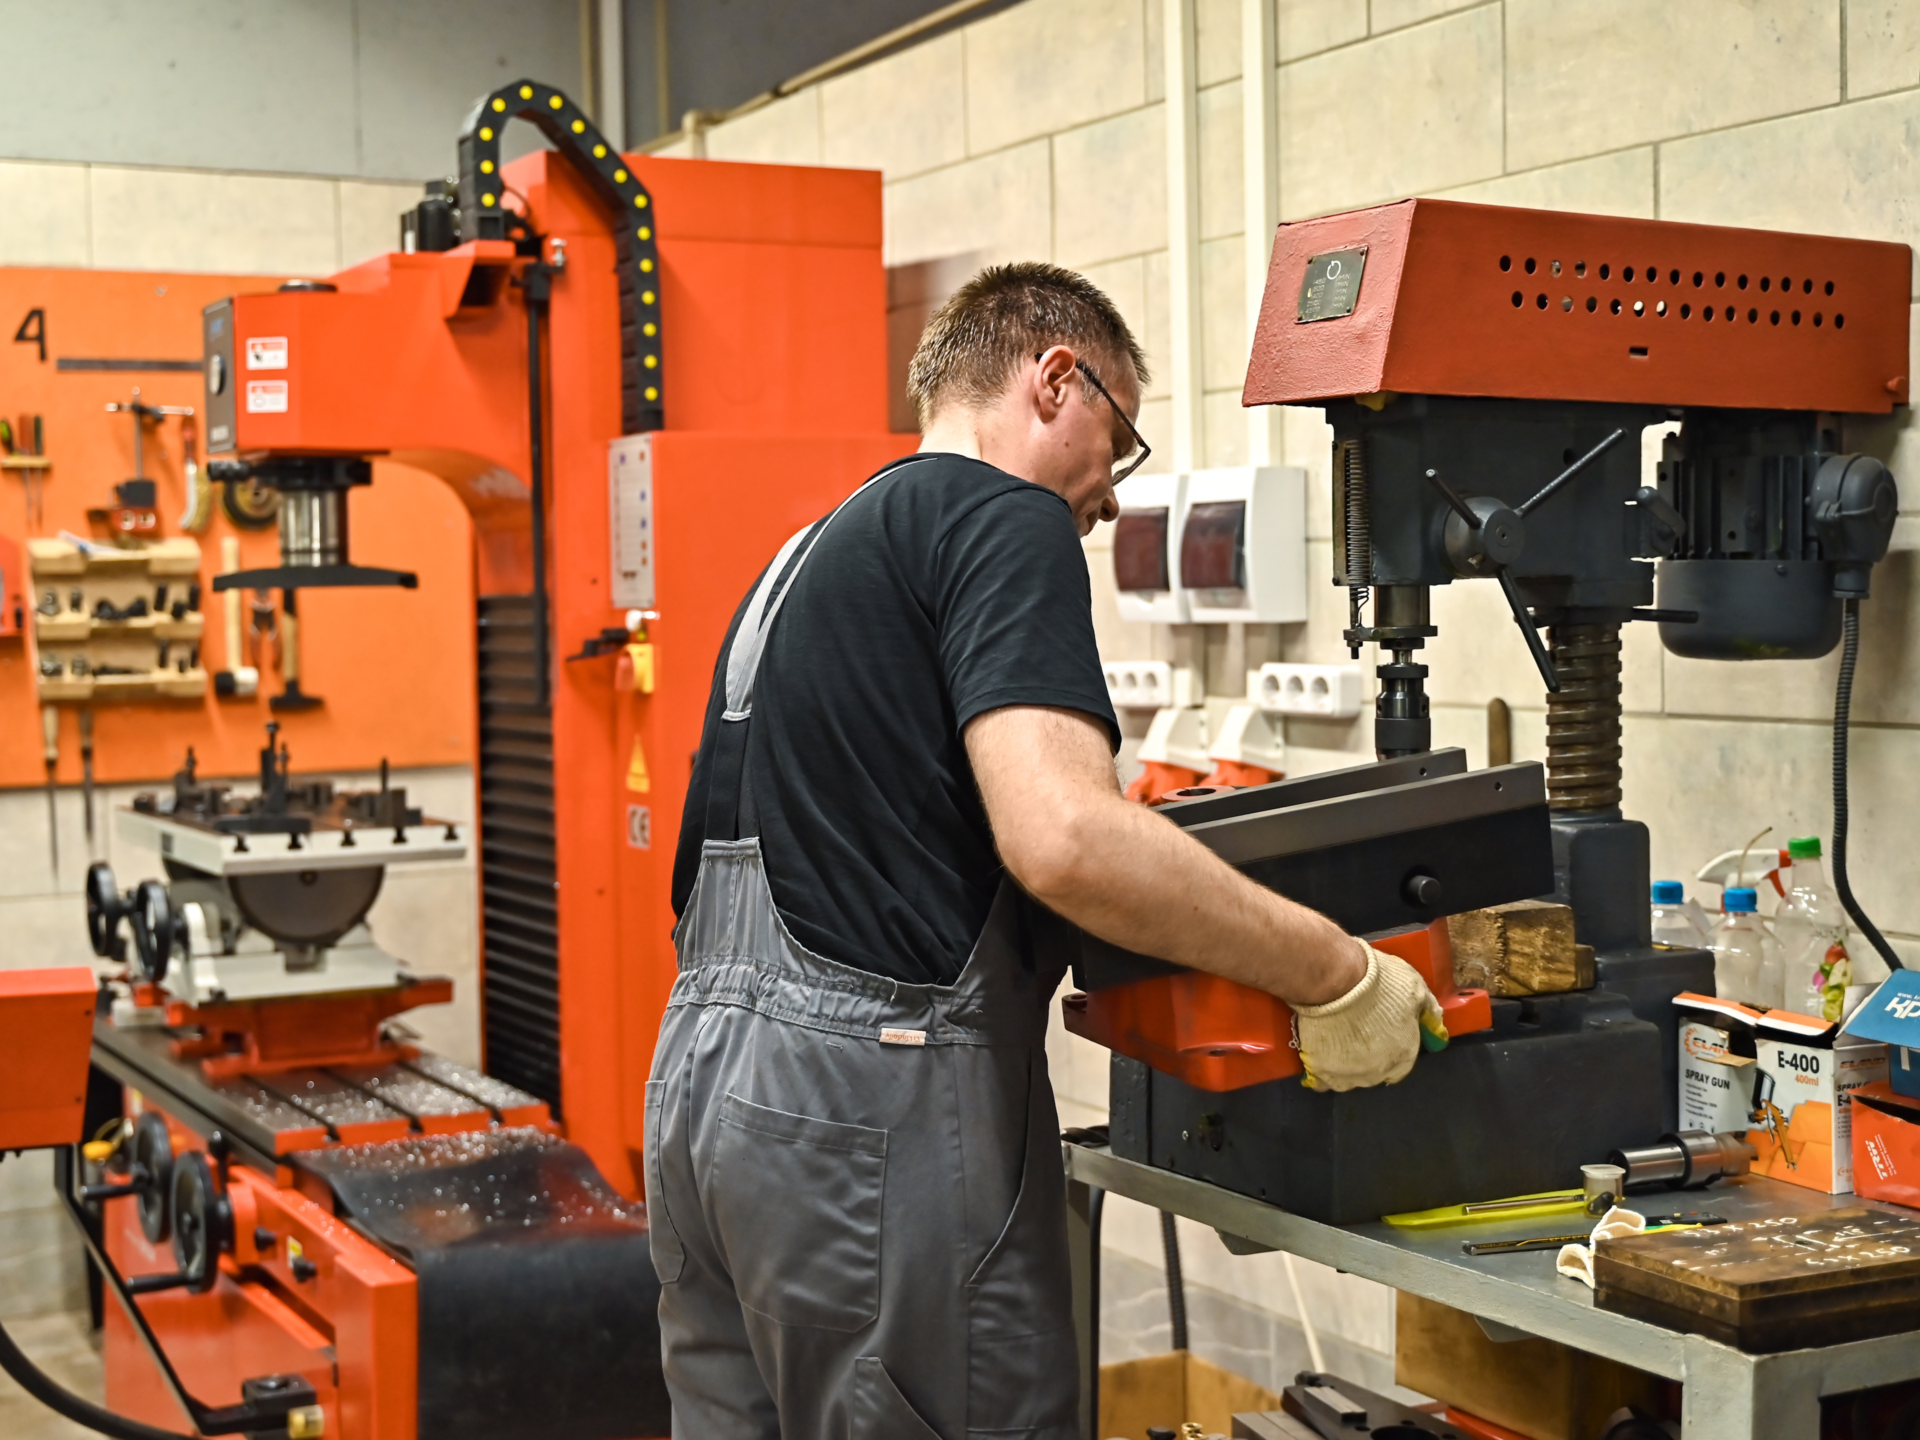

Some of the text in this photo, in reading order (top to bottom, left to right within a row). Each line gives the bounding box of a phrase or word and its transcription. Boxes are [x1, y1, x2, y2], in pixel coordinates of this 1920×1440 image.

[14, 308, 47, 362] 4
[1777, 1050, 1820, 1074] E-400
[1685, 1068, 1710, 1084] SPRAY
[1711, 1076, 1730, 1091] GUN
[1795, 1074, 1819, 1086] 400ml
[1837, 1082, 1862, 1092] SPRAY
[1837, 1095, 1851, 1107] E-4
[1865, 1140, 1888, 1180] TRW
[1748, 1217, 1798, 1229] 250
[1858, 1245, 1911, 1258] 250
